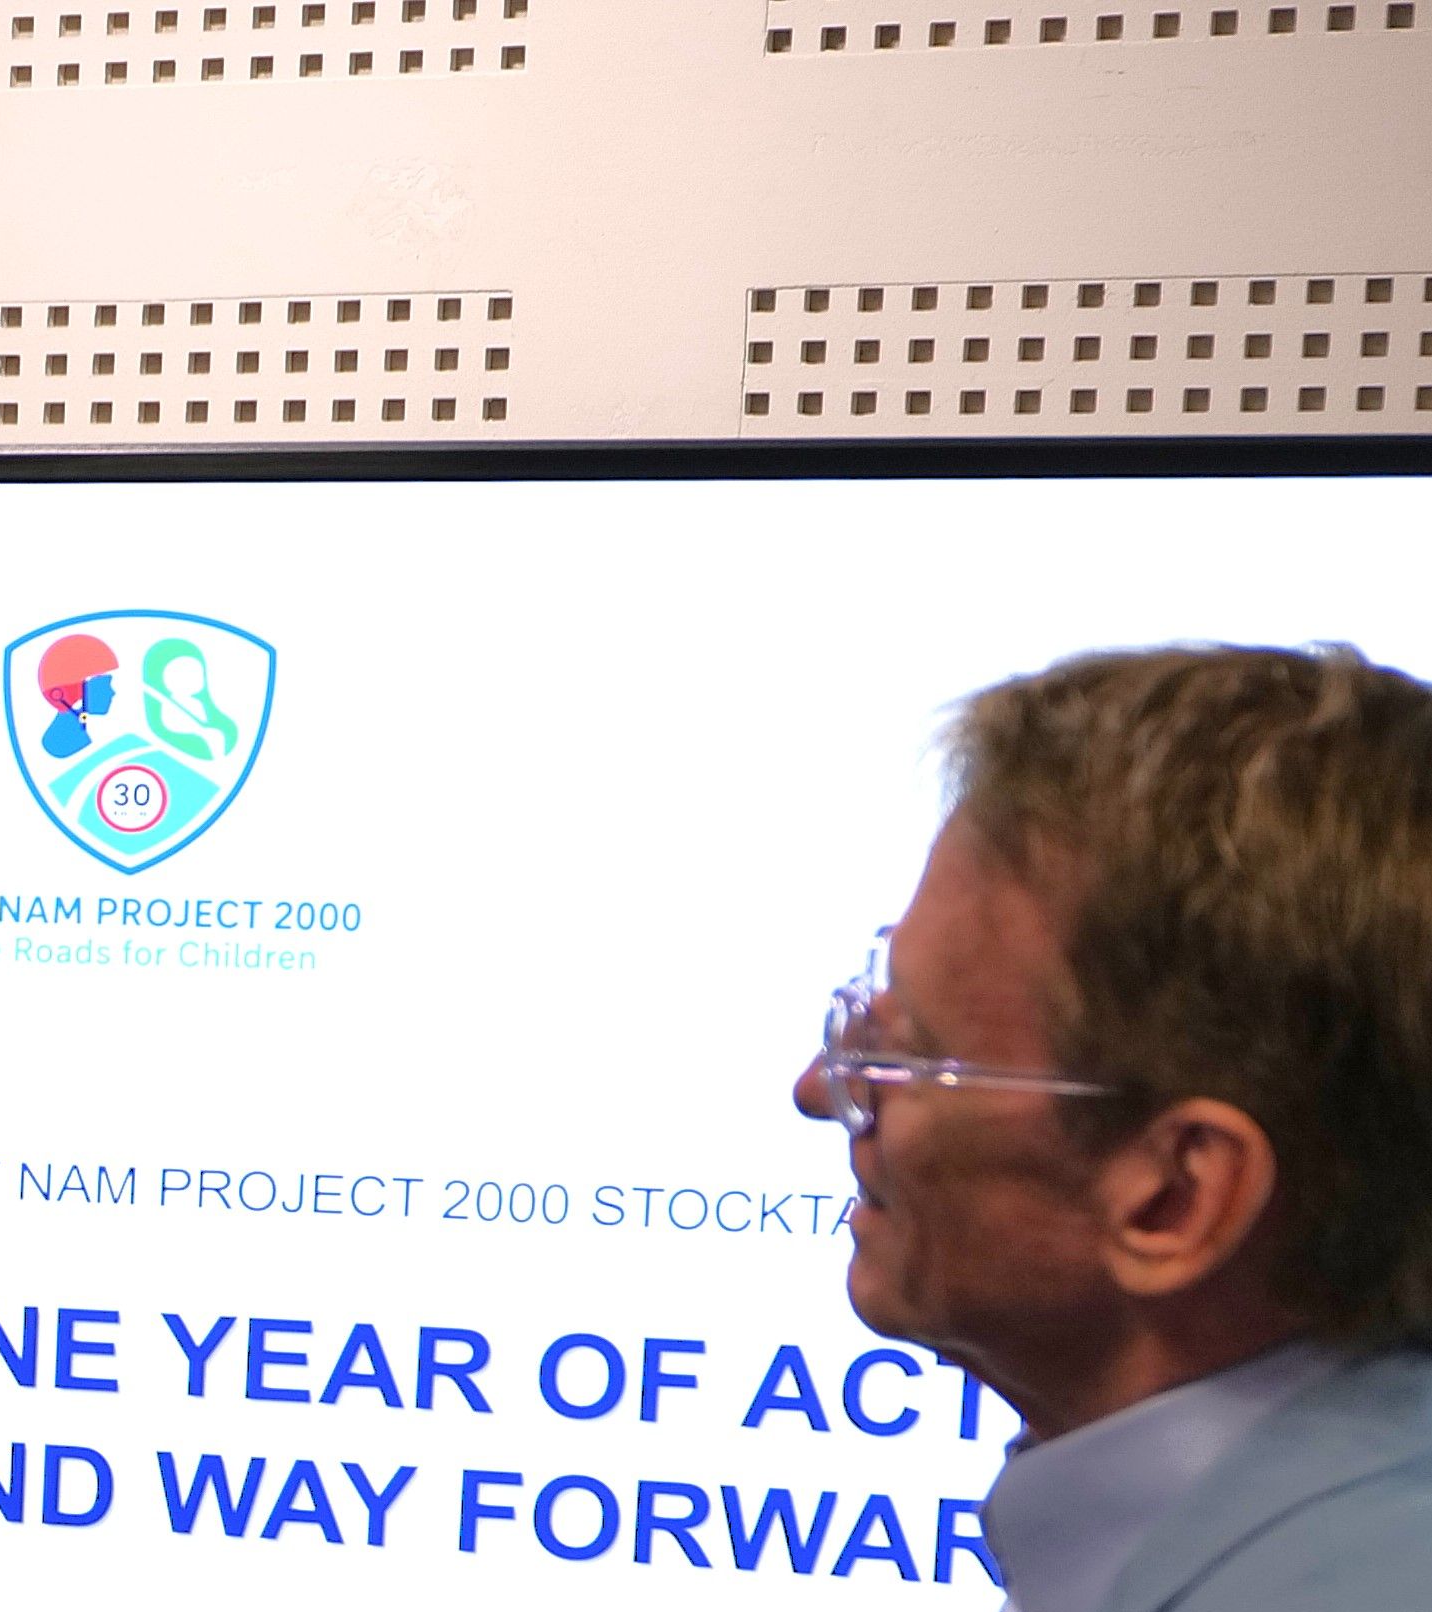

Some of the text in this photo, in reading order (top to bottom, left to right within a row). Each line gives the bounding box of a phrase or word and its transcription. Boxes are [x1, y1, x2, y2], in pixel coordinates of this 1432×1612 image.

[114, 783, 150, 806] 30
[0, 896, 81, 924] NAM
[98, 898, 263, 928] PROJECT
[275, 902, 360, 931] 2000
[15, 937, 110, 964] Roads
[123, 940, 166, 966] for
[180, 941, 315, 970] Children
[20, 1163, 135, 1204] NAM
[161, 1169, 423, 1216] PROJECT
[443, 1180, 568, 1224] 2000
[161, 1313, 493, 1414] YEAR
[539, 1333, 706, 1423] OF
[156, 1451, 418, 1547] WAY
[459, 1469, 1003, 1588] FORWAR
